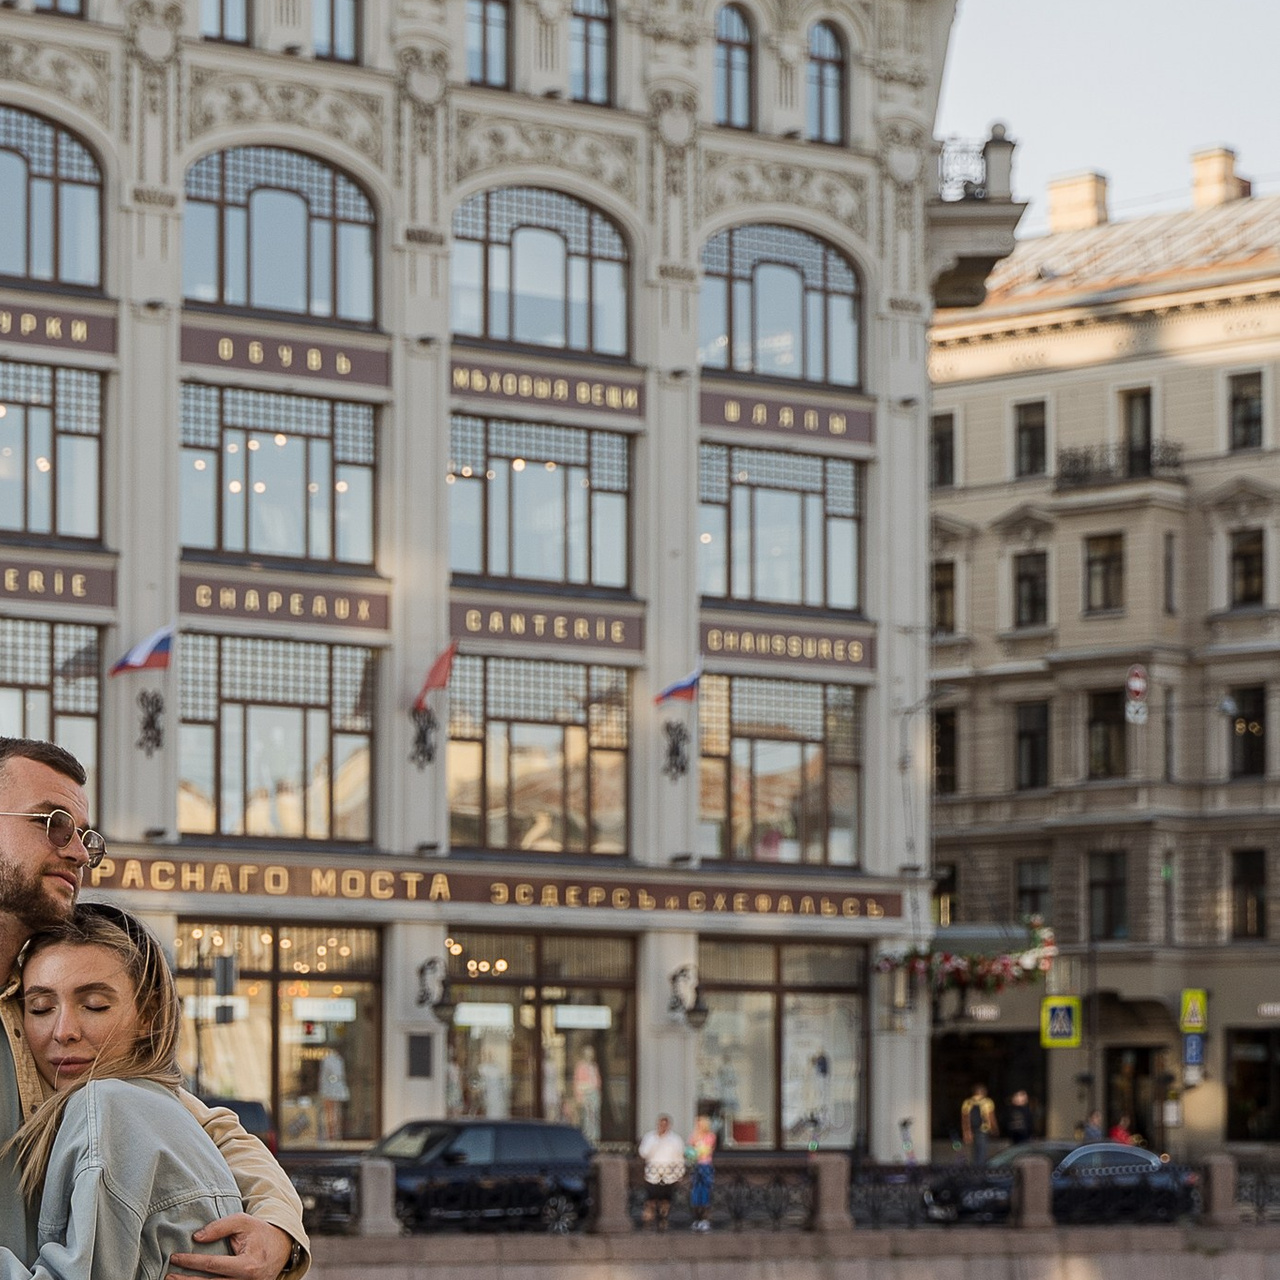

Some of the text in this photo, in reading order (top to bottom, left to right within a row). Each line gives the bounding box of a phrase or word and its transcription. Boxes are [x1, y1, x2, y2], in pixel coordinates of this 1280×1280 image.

[218, 338, 351, 375] ОБУВЬ
[196, 585, 370, 620] CHAPEAUX
[707, 629, 863, 662] CHAUSSURES
[91, 858, 288, 894] РАСНАГО
[311, 868, 450, 901] МОСТА
